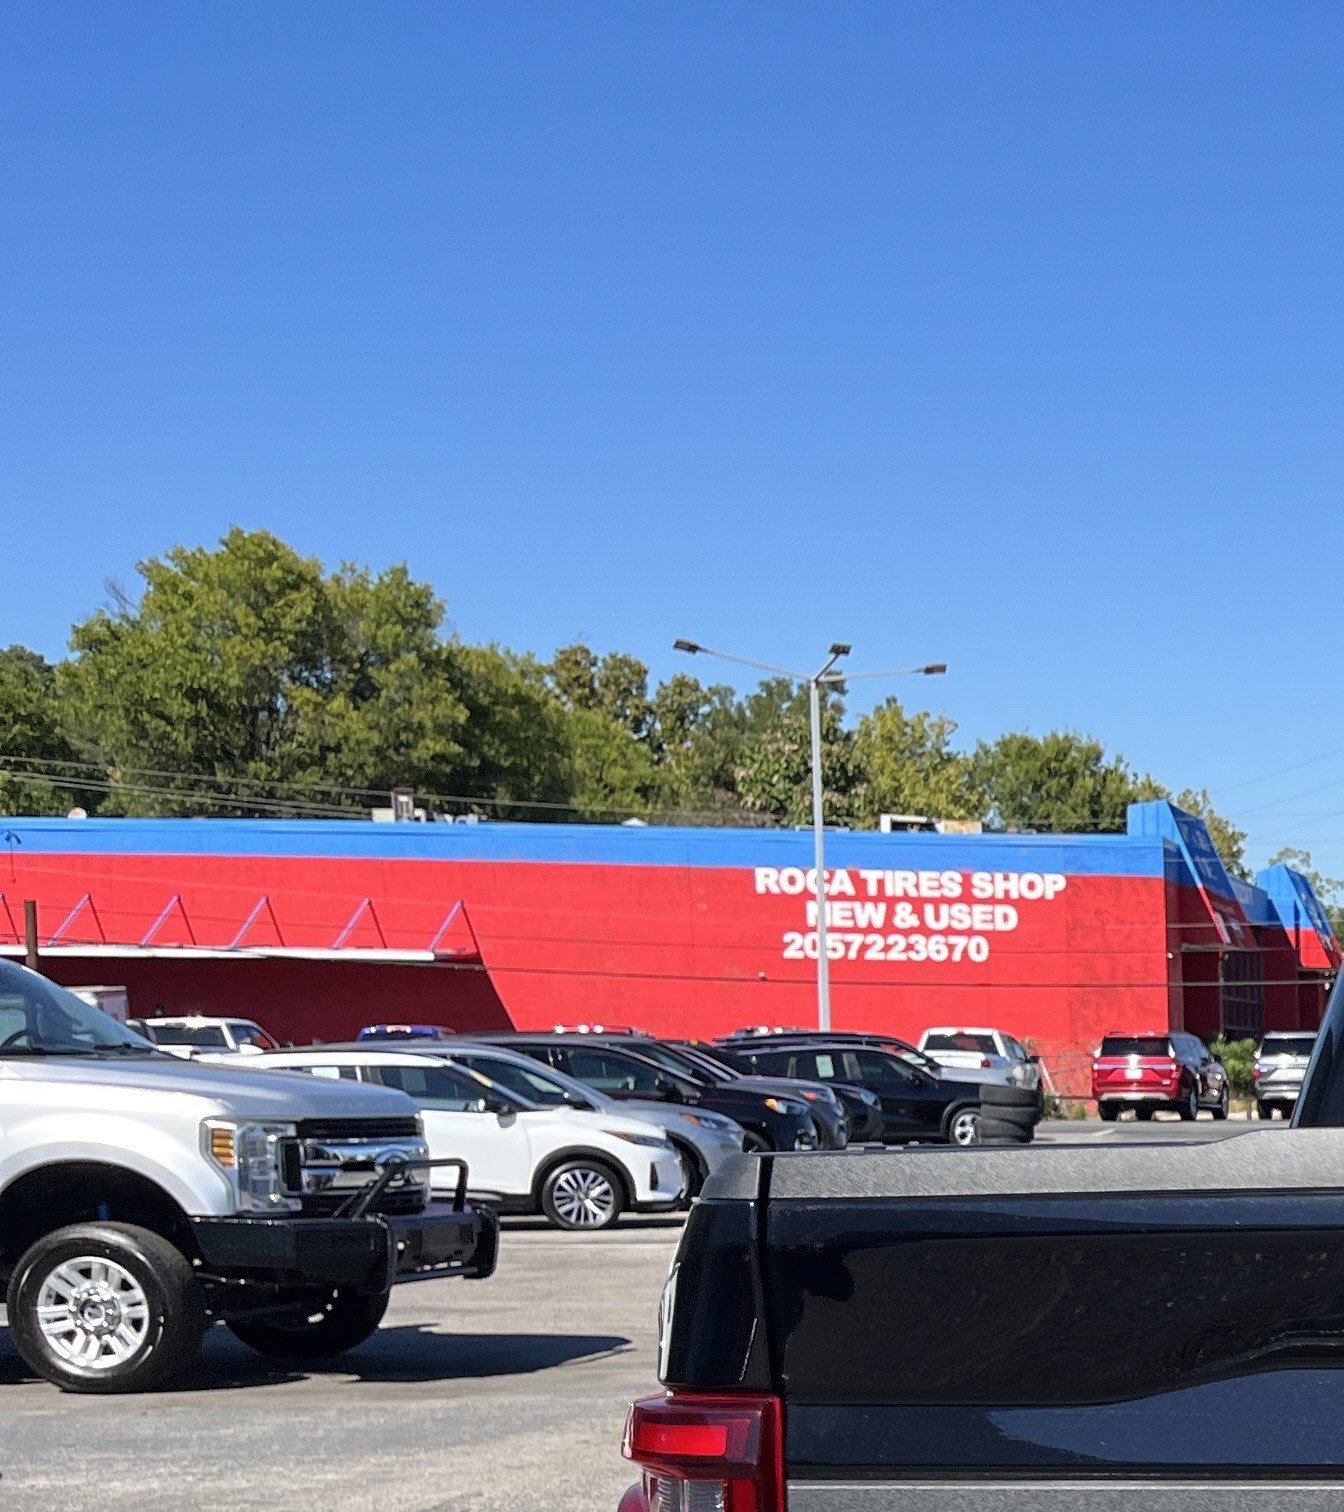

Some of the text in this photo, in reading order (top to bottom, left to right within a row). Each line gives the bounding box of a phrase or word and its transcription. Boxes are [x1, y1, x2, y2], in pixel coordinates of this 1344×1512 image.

[754, 867, 1067, 900] ROCA TIRES SHOP
[805, 900, 1019, 932] NEW & USED
[782, 932, 990, 962] 2057223670
